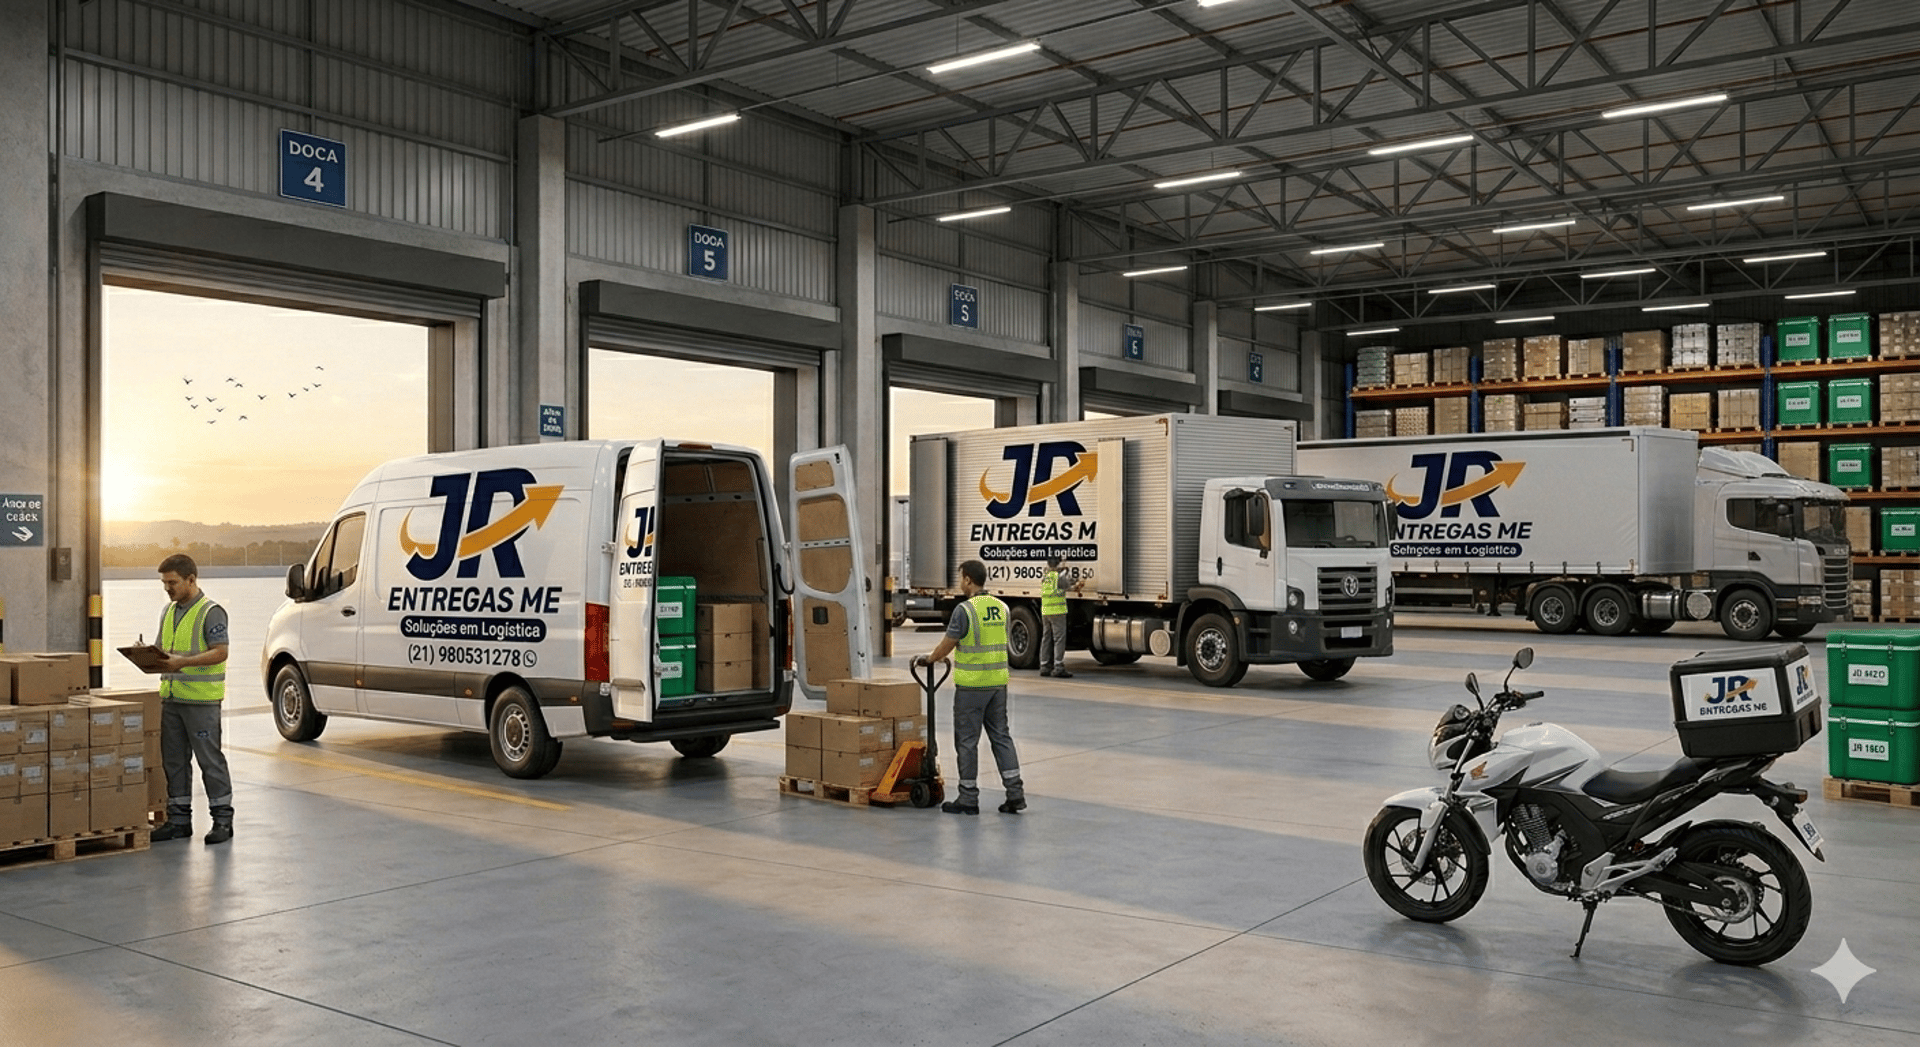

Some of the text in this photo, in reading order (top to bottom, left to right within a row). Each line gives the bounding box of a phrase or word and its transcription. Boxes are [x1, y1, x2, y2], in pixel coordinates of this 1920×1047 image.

[289, 140, 338, 163] DOCA
[304, 166, 324, 193] 4
[694, 231, 725, 249] DOCA
[704, 250, 716, 271] 5
[985, 441, 1088, 519] JR
[1396, 451, 1504, 519] JR
[405, 468, 537, 581] JR
[970, 521, 1097, 541] ENTREGAS M
[1396, 522, 1533, 540] NTREGAS ME
[1030, 548, 1046, 558] em
[1444, 546, 1462, 555] em
[388, 586, 563, 613] ENTREGAS ME
[982, 606, 1002, 621] JR
[405, 619, 457, 638] Soluções
[460, 622, 479, 636] em
[408, 643, 521, 667] (21) 980531278
[1706, 675, 1752, 704] JR
